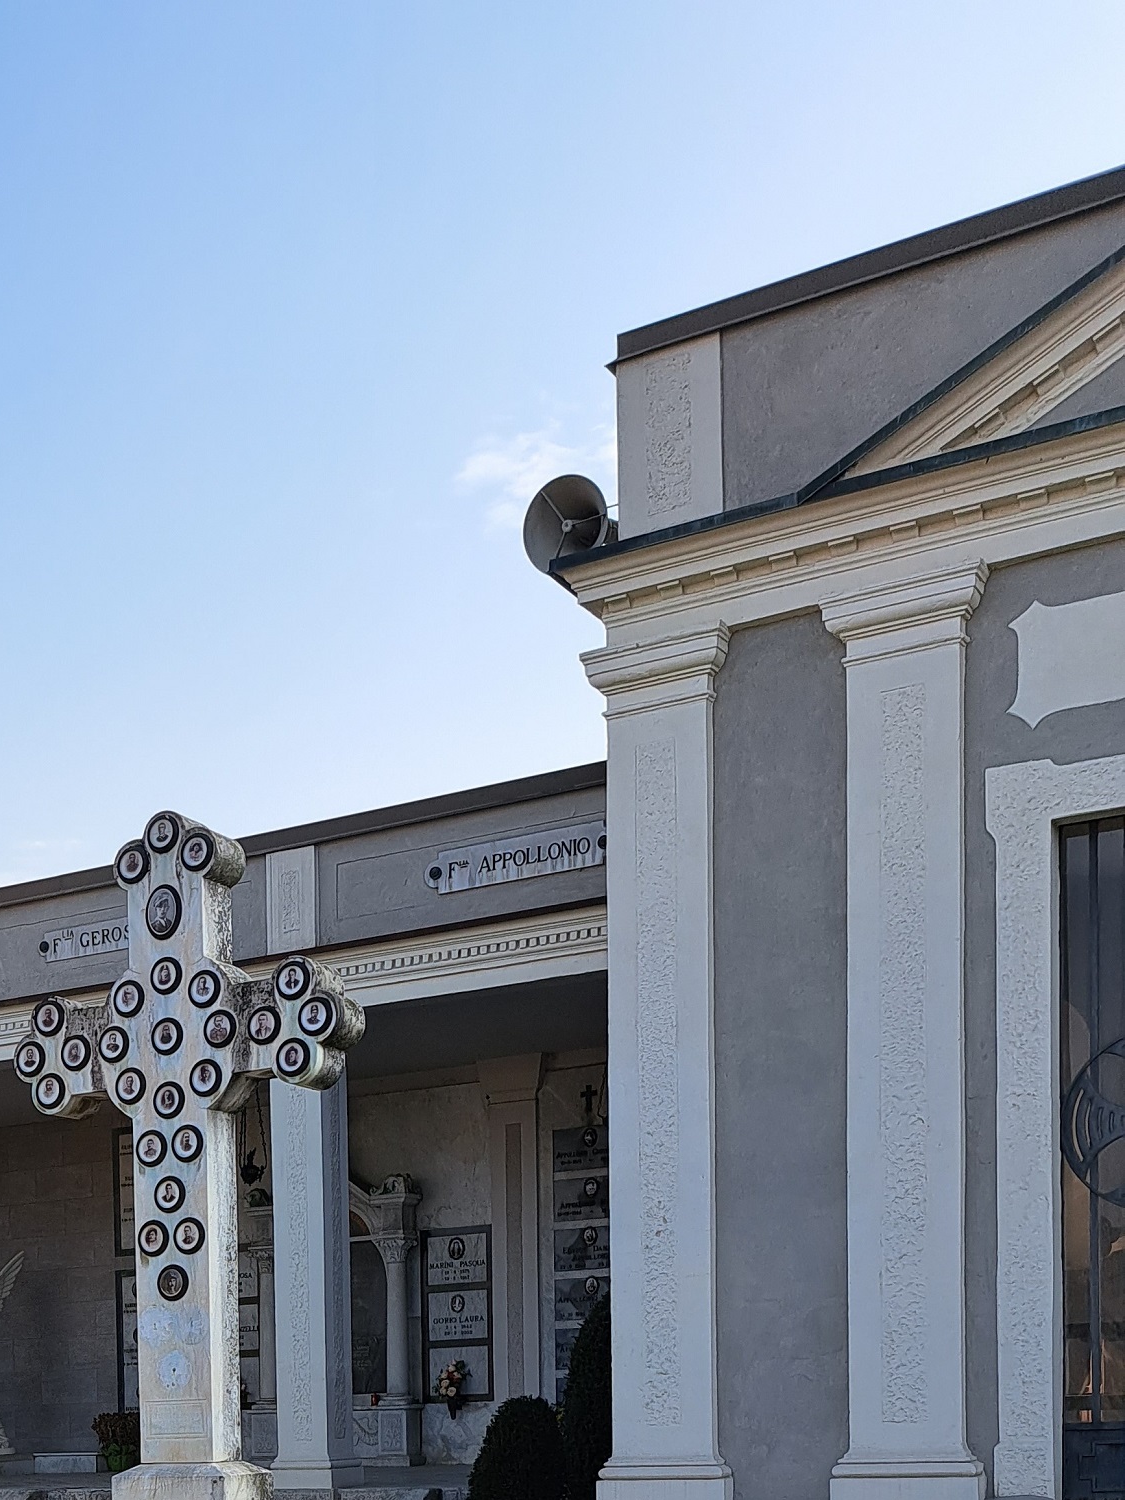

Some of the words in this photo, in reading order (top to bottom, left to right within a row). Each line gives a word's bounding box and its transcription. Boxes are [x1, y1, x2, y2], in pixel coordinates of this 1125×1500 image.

[478, 837, 591, 873] APPOLLONIO
[429, 1261, 453, 1269] MARINI
[460, 1259, 485, 1267] PASQUA
[433, 1317, 457, 1325] GORIO
[459, 1315, 485, 1323] LAURA
